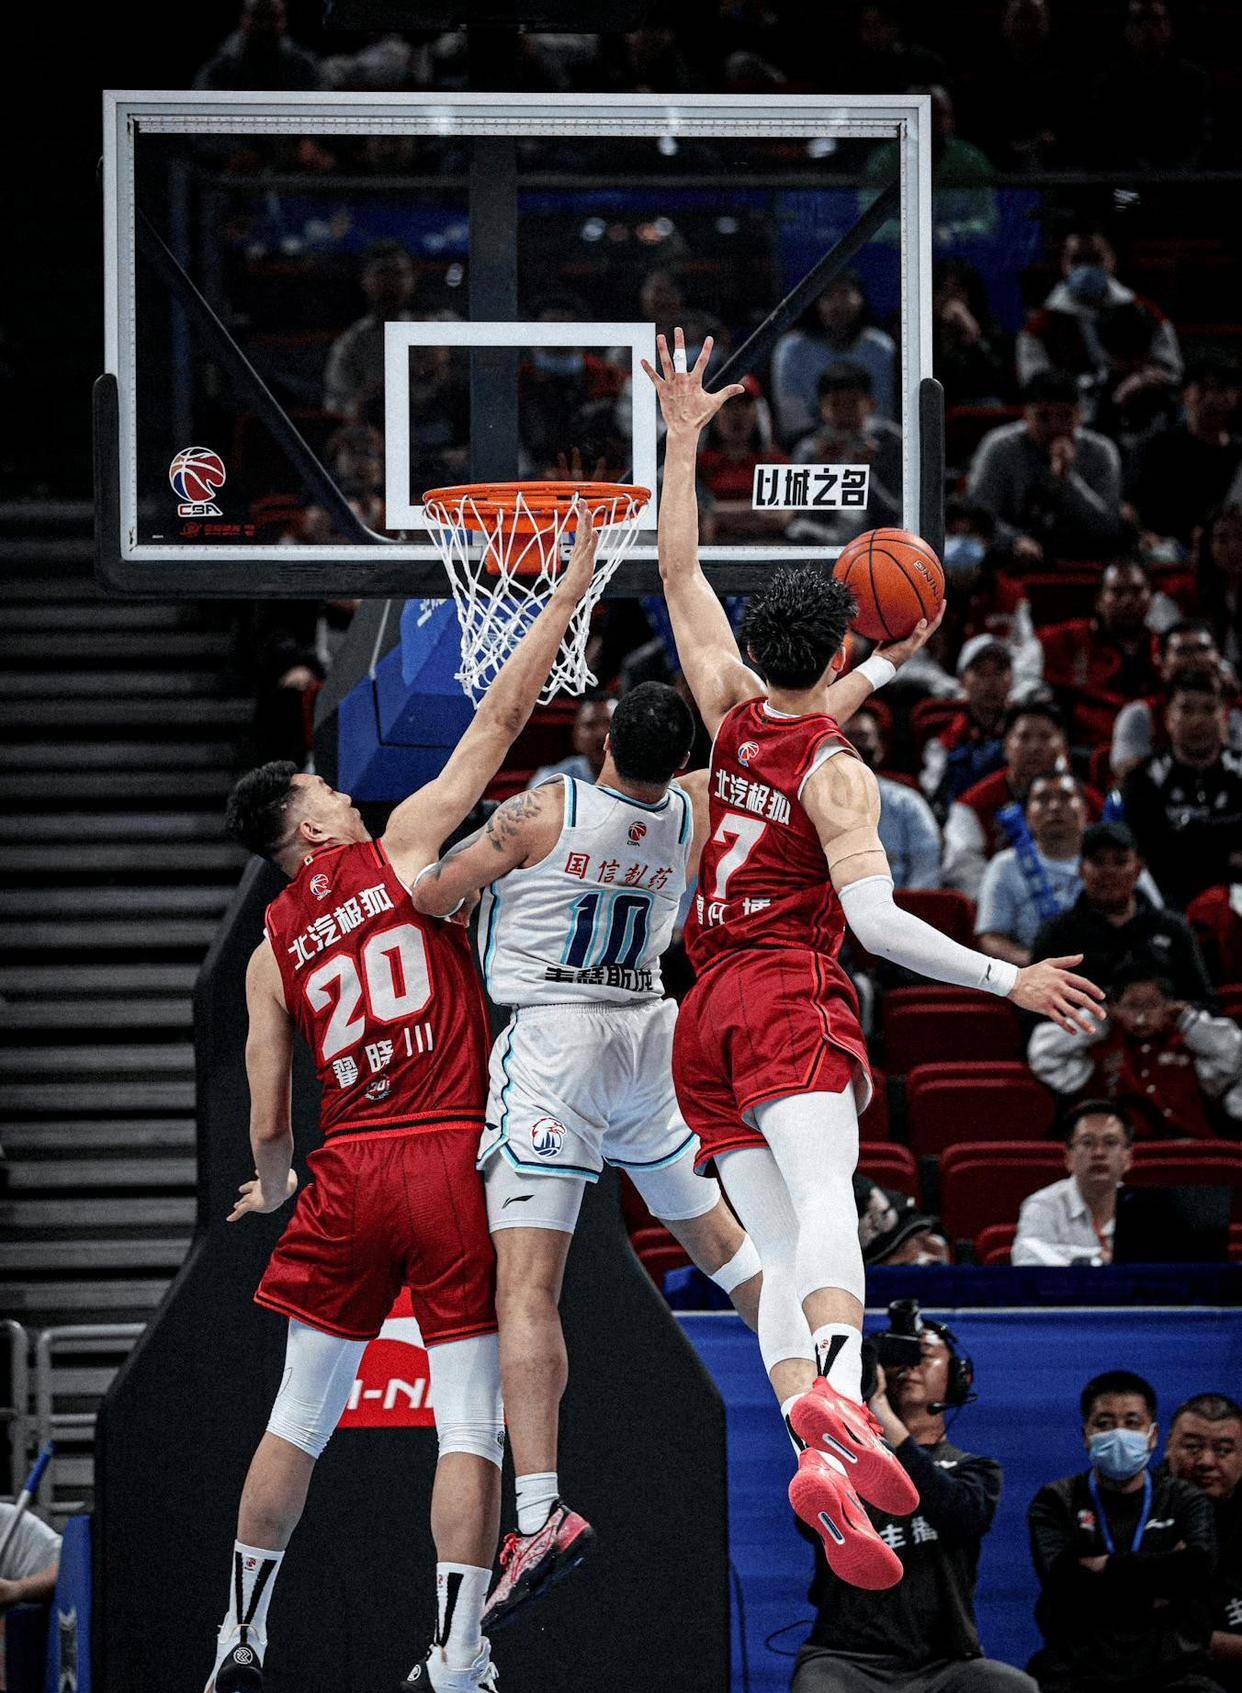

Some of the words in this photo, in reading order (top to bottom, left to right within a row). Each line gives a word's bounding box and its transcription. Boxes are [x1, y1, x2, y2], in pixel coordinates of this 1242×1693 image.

[179, 503, 222, 517] CBA
[756, 468, 866, 506] 以城之名
[714, 768, 791, 826] 北汽极狐
[565, 851, 673, 890] 国信制药
[712, 812, 767, 900] 7
[288, 883, 395, 971] 北汽极狐
[560, 890, 656, 969] 10
[304, 922, 433, 1062] 20
